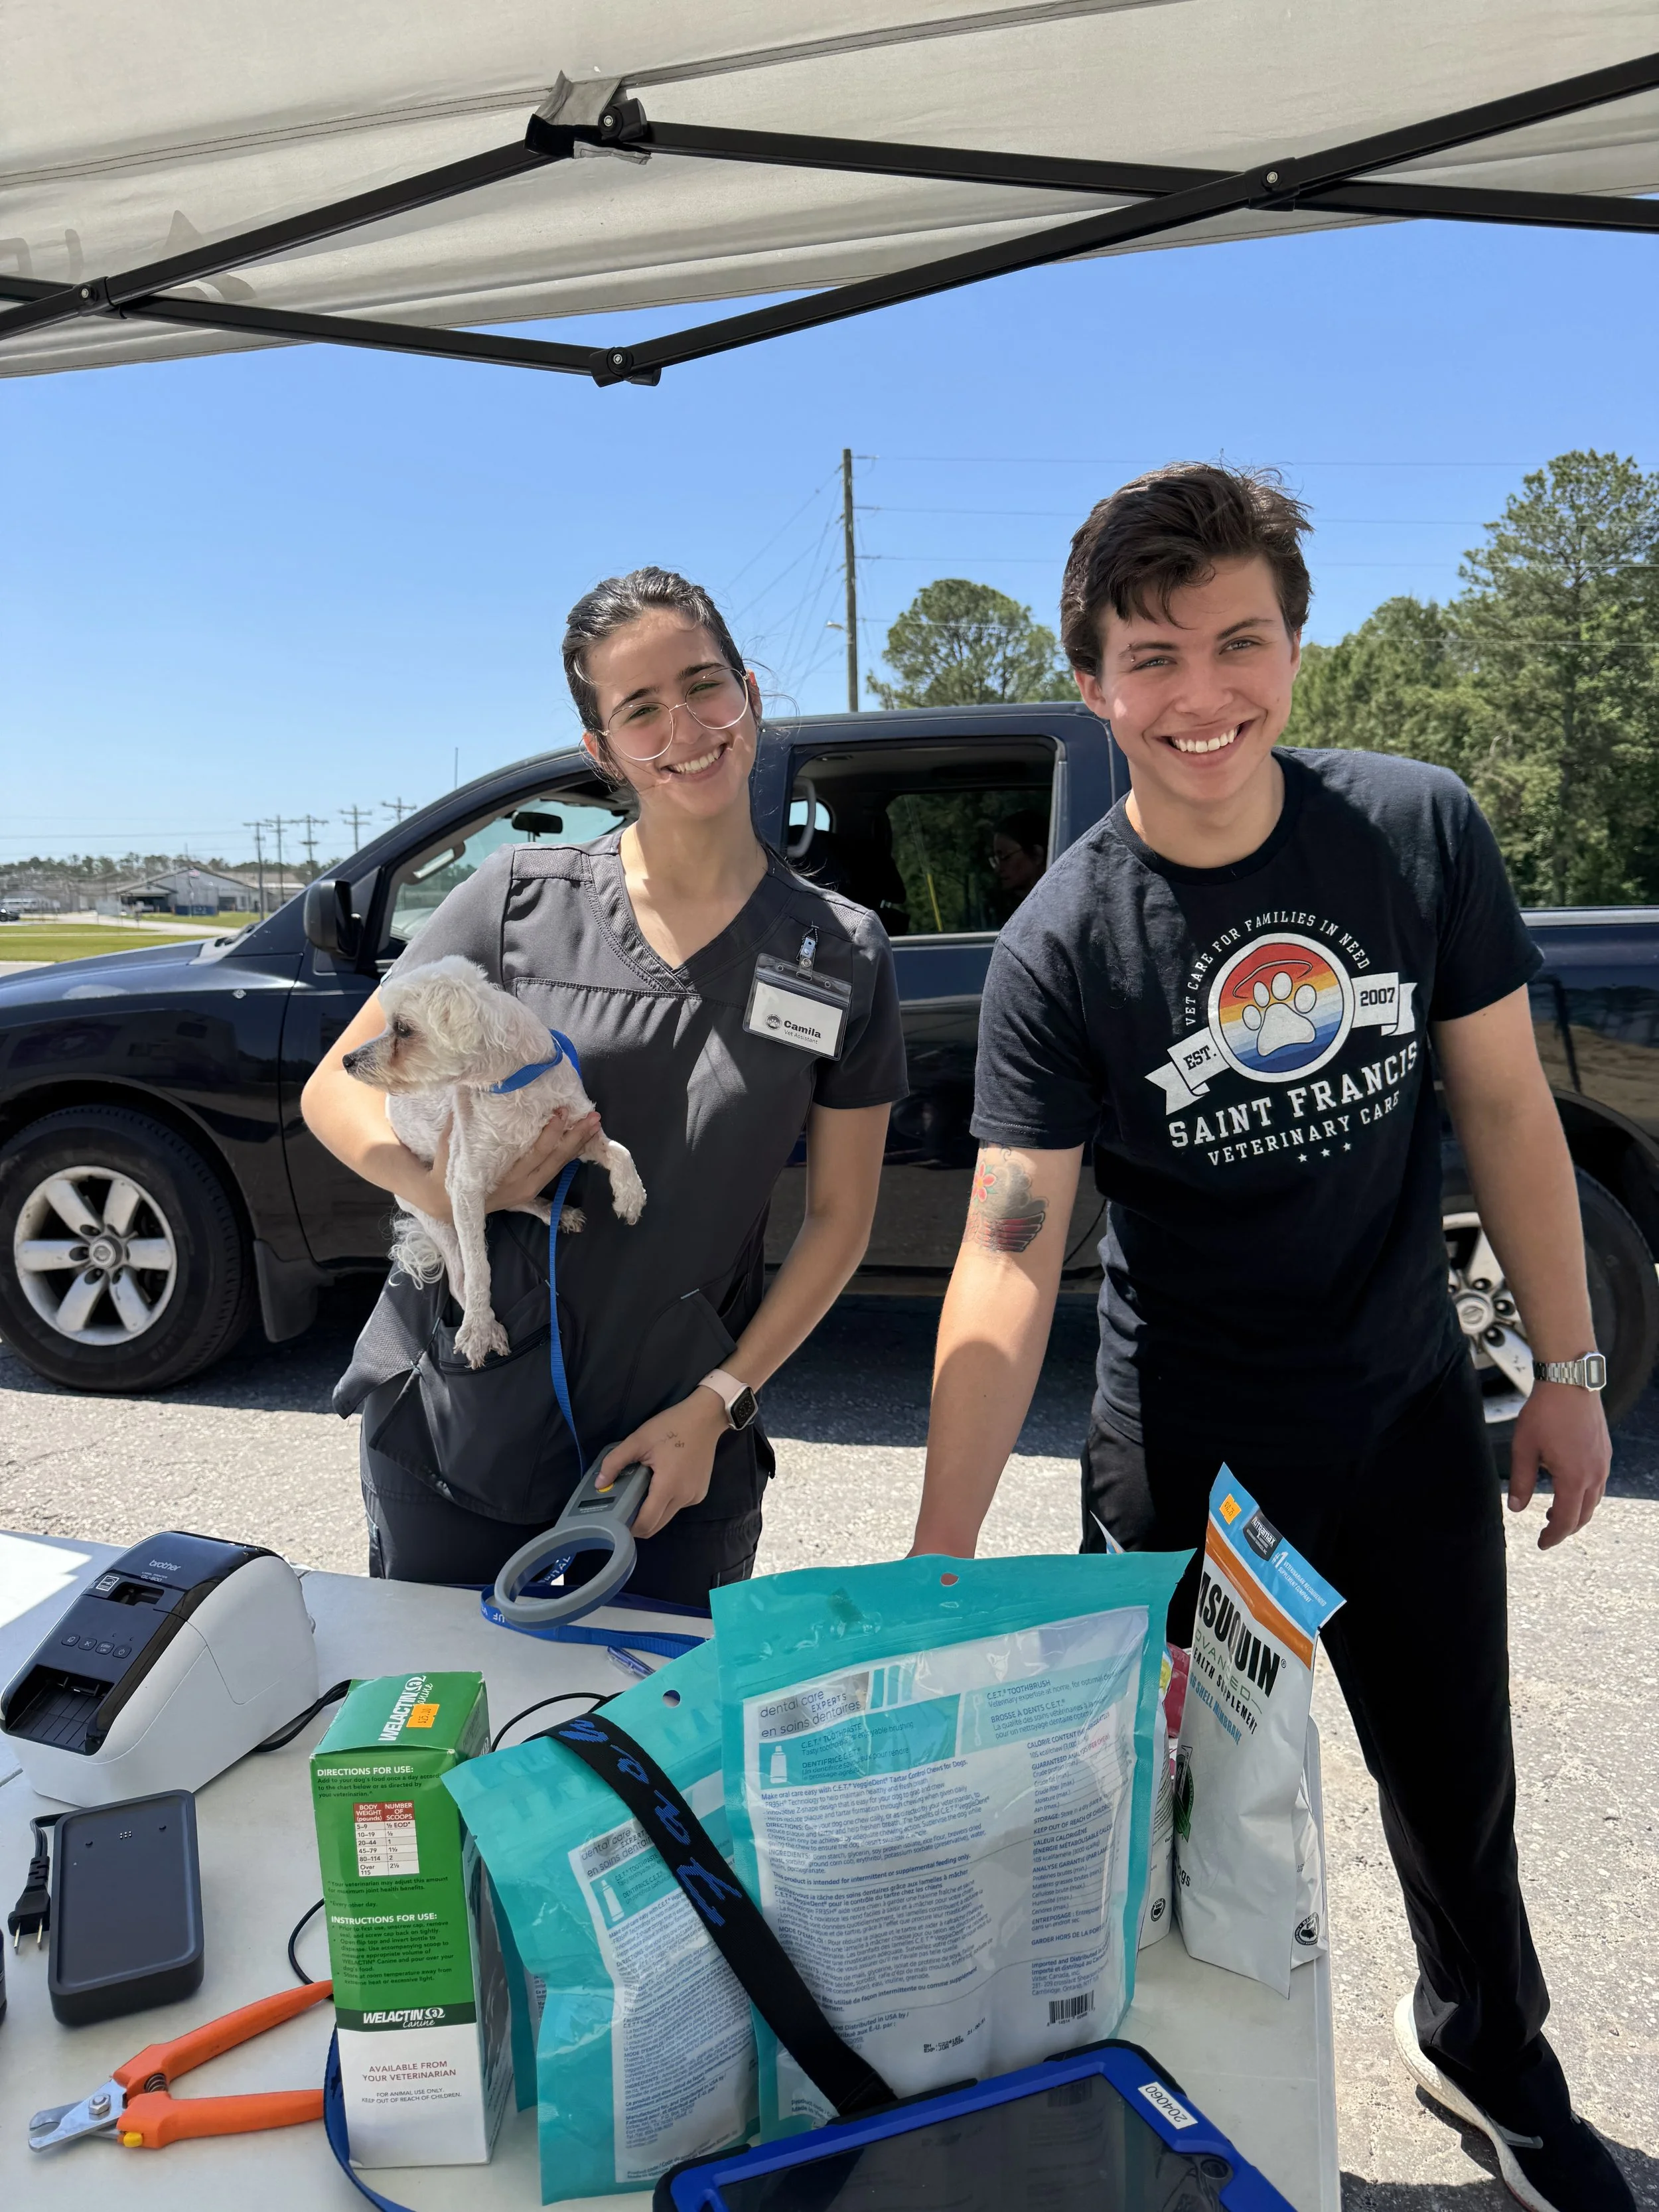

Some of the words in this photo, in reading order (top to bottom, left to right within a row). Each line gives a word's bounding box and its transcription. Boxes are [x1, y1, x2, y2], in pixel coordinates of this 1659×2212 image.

[1245, 911, 1316, 932] FAMILIES
[1319, 920, 1338, 935] IN
[1212, 929, 1240, 952] FOR
[1338, 933, 1370, 970] NEED
[1188, 953, 1213, 991] CARE
[1360, 988, 1395, 1006] 2007
[1186, 997, 1196, 1025] VET
[784, 1020, 821, 1039] Camila
[794, 1033, 818, 1044] Assistant
[1183, 1045, 1217, 1070] EST.
[1169, 1096, 1272, 1148] SAINT
[1286, 1041, 1417, 1118] FRANCIS
[1208, 1115, 1352, 1166] VETERINARY
[1360, 1091, 1400, 1125] CARE
[149, 1560, 181, 1571] brother
[1271, 1552, 1289, 1568] #1
[1278, 1567, 1298, 1587] SUPPLEMENT
[1283, 1561, 1305, 1585] VETERINARIAN
[1303, 1582, 1327, 1607] RECOMMENDED
[417, 1683, 433, 1704] anine
[1007, 1680, 1051, 1694] TOOTHBRUSH
[760, 1698, 798, 1718] dental
[801, 1690, 824, 1705] care
[812, 1693, 847, 1713] EXPERTS
[1216, 1672, 1258, 1734] SUPPLEMENT
[378, 1690, 420, 1740] WELACTIN
[761, 1728, 776, 1737] en
[780, 1719, 810, 1734] soins
[812, 1700, 862, 1725] dentaires
[991, 1710, 1016, 1723] BROSSE
[1023, 1704, 1045, 1716] DENTS
[1196, 1681, 1213, 1708] SHELL
[1213, 1701, 1242, 1746] MEMBRANE
[1027, 1739, 1050, 1749] CALORIE
[1052, 1732, 1076, 1743] CONTENT
[802, 1754, 842, 1768] DENTIFRICE
[908, 1769, 926, 1779] Control
[926, 1765, 943, 1774] Chews
[952, 1760, 968, 1769] Dogs.
[1032, 1755, 1067, 1770] GUARANTEED
[581, 1839, 610, 1860] dental
[613, 1830, 630, 1844] care
[620, 1830, 648, 1848] EXPERT
[587, 1866, 598, 1878] en
[599, 1854, 620, 1871] soins
[851, 1872, 887, 1883] intermittent
[896, 1863, 935, 1875] supplemental
[936, 1857, 956, 1868] feeding
[958, 1854, 971, 1862] only.
[331, 1916, 394, 1925] INSTRUCTIONS
[1031, 1960, 1056, 1969] Imported
[1070, 1950, 1098, 1962] Distributed
[364, 2010, 423, 2024] WELACTIN
[403, 2019, 435, 2028] Canine
[370, 2063, 417, 2072] AVAILABLE
[390, 2069, 456, 2081] VETERINARIAN
[1145, 2085, 1188, 2123] 204060
